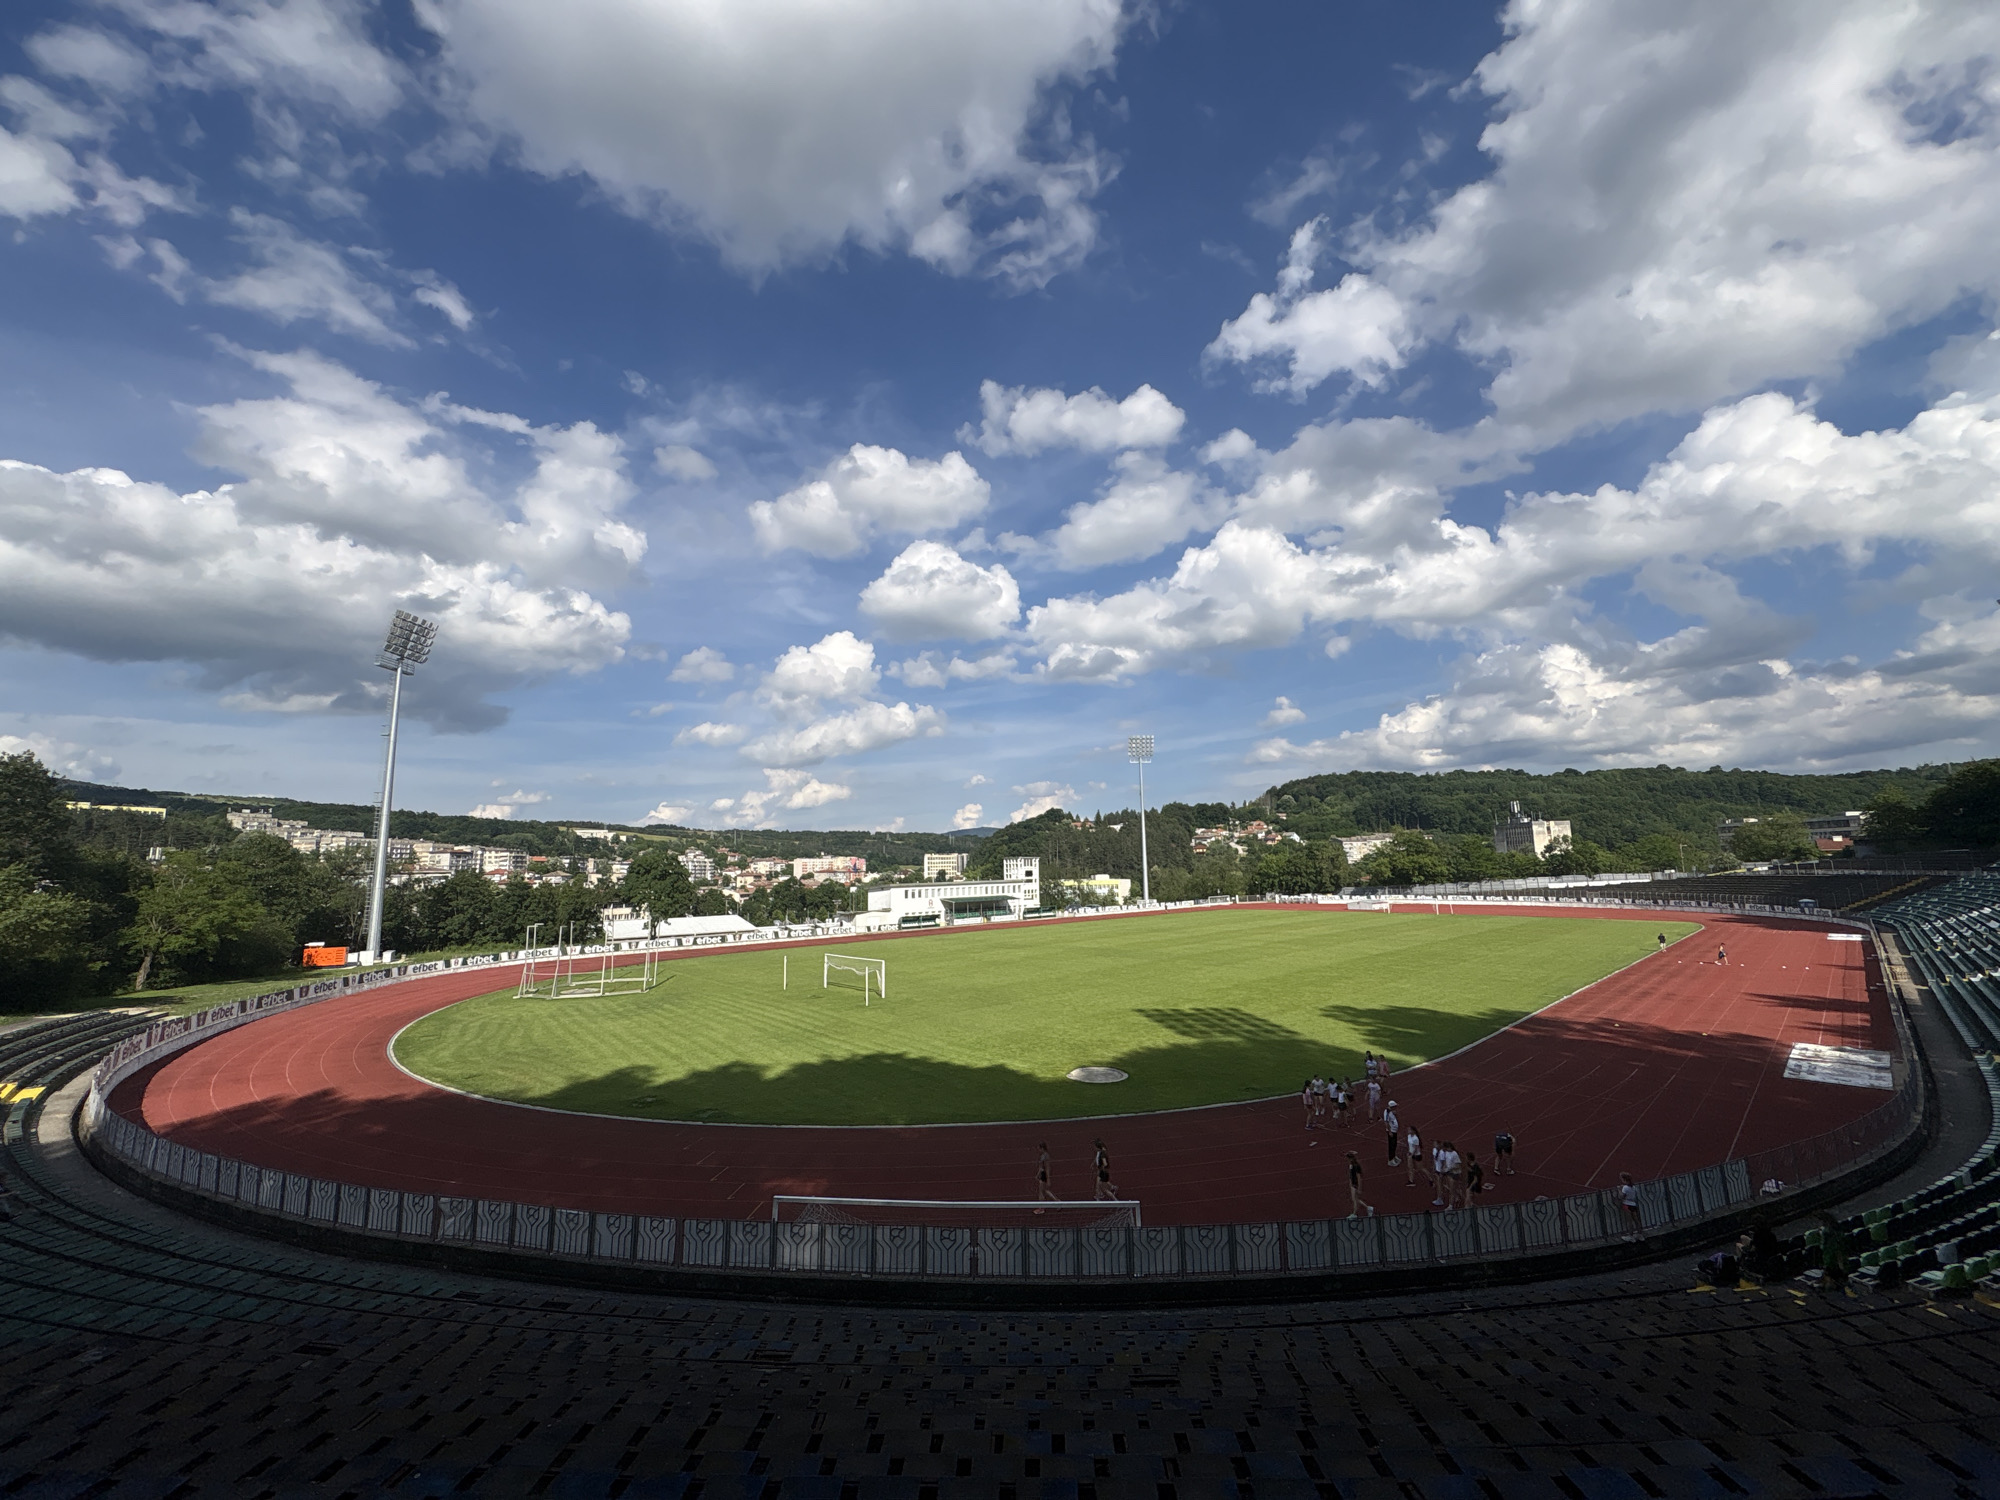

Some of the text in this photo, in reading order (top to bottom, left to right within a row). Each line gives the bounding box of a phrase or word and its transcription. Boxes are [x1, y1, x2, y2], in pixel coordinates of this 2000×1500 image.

[696, 935, 723, 945] efbet
[747, 931, 769, 940] efbet
[583, 944, 615, 954] efbet
[645, 939, 671, 948] efbet
[524, 948, 553, 958] efbet
[467, 955, 495, 966] efbet
[412, 962, 439, 974] efbet
[363, 969, 387, 982] efbet
[314, 980, 337, 995] efbet
[262, 992, 289, 1007] efbet
[211, 1005, 234, 1022] efbet
